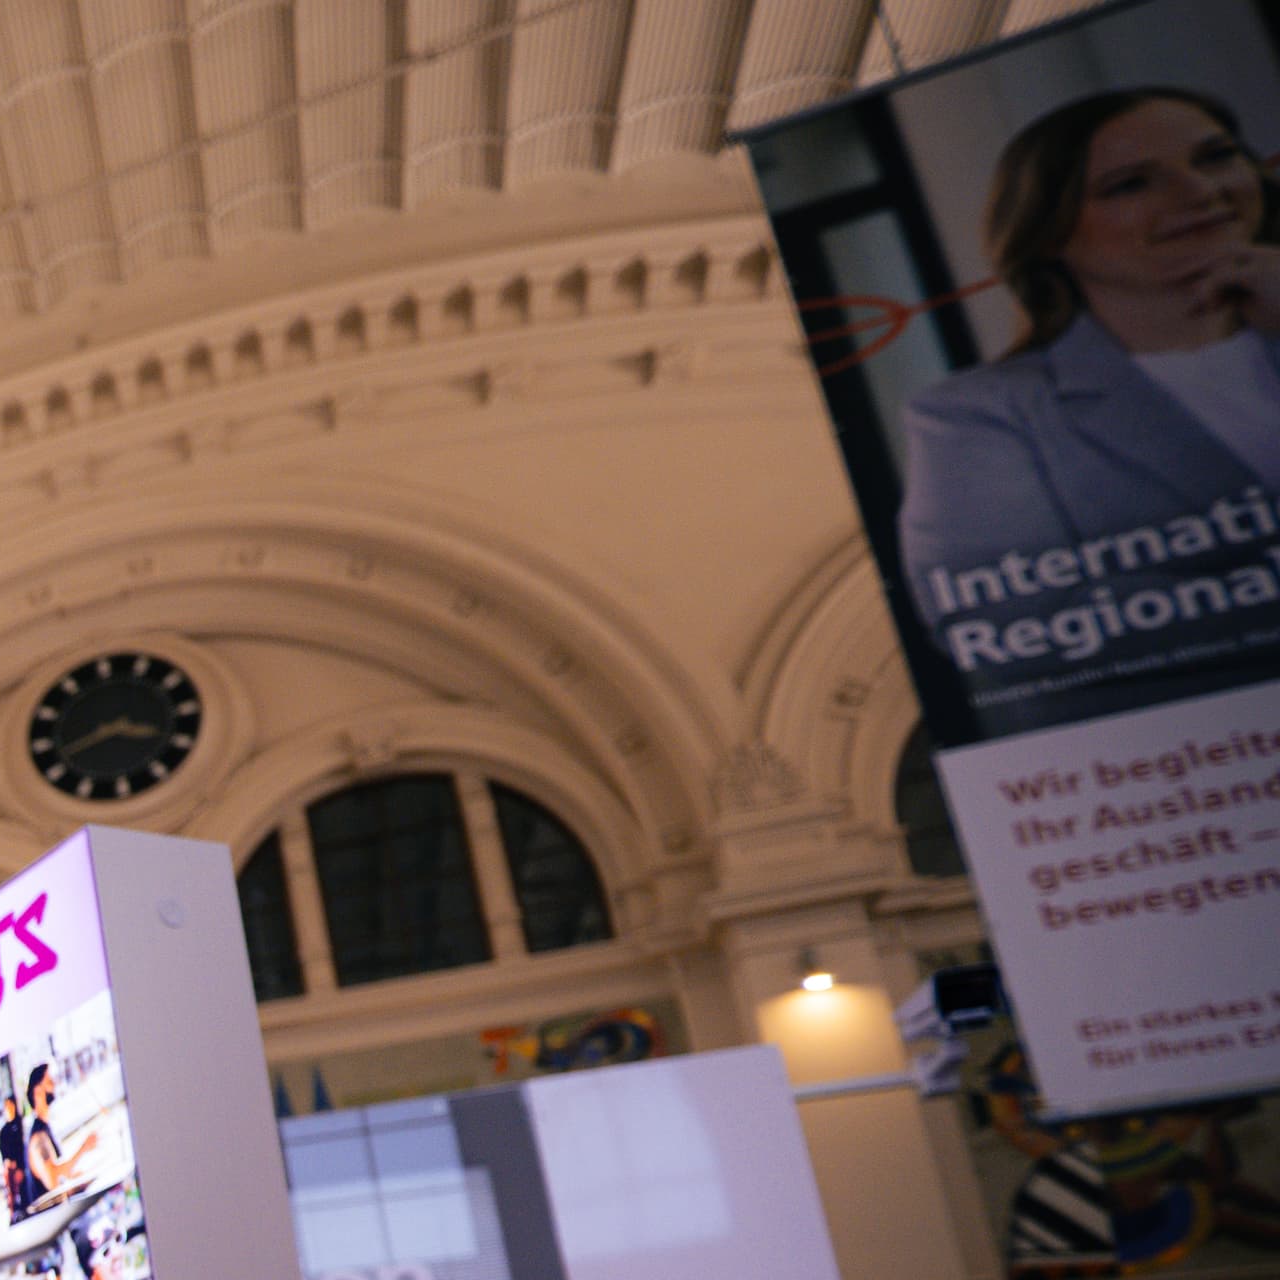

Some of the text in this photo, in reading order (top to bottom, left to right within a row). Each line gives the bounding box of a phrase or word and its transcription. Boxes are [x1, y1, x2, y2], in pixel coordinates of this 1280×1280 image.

[998, 765, 1080, 806] Wir
[1012, 814, 1077, 849] Ihr
[1030, 825, 1238, 893] geschäft
